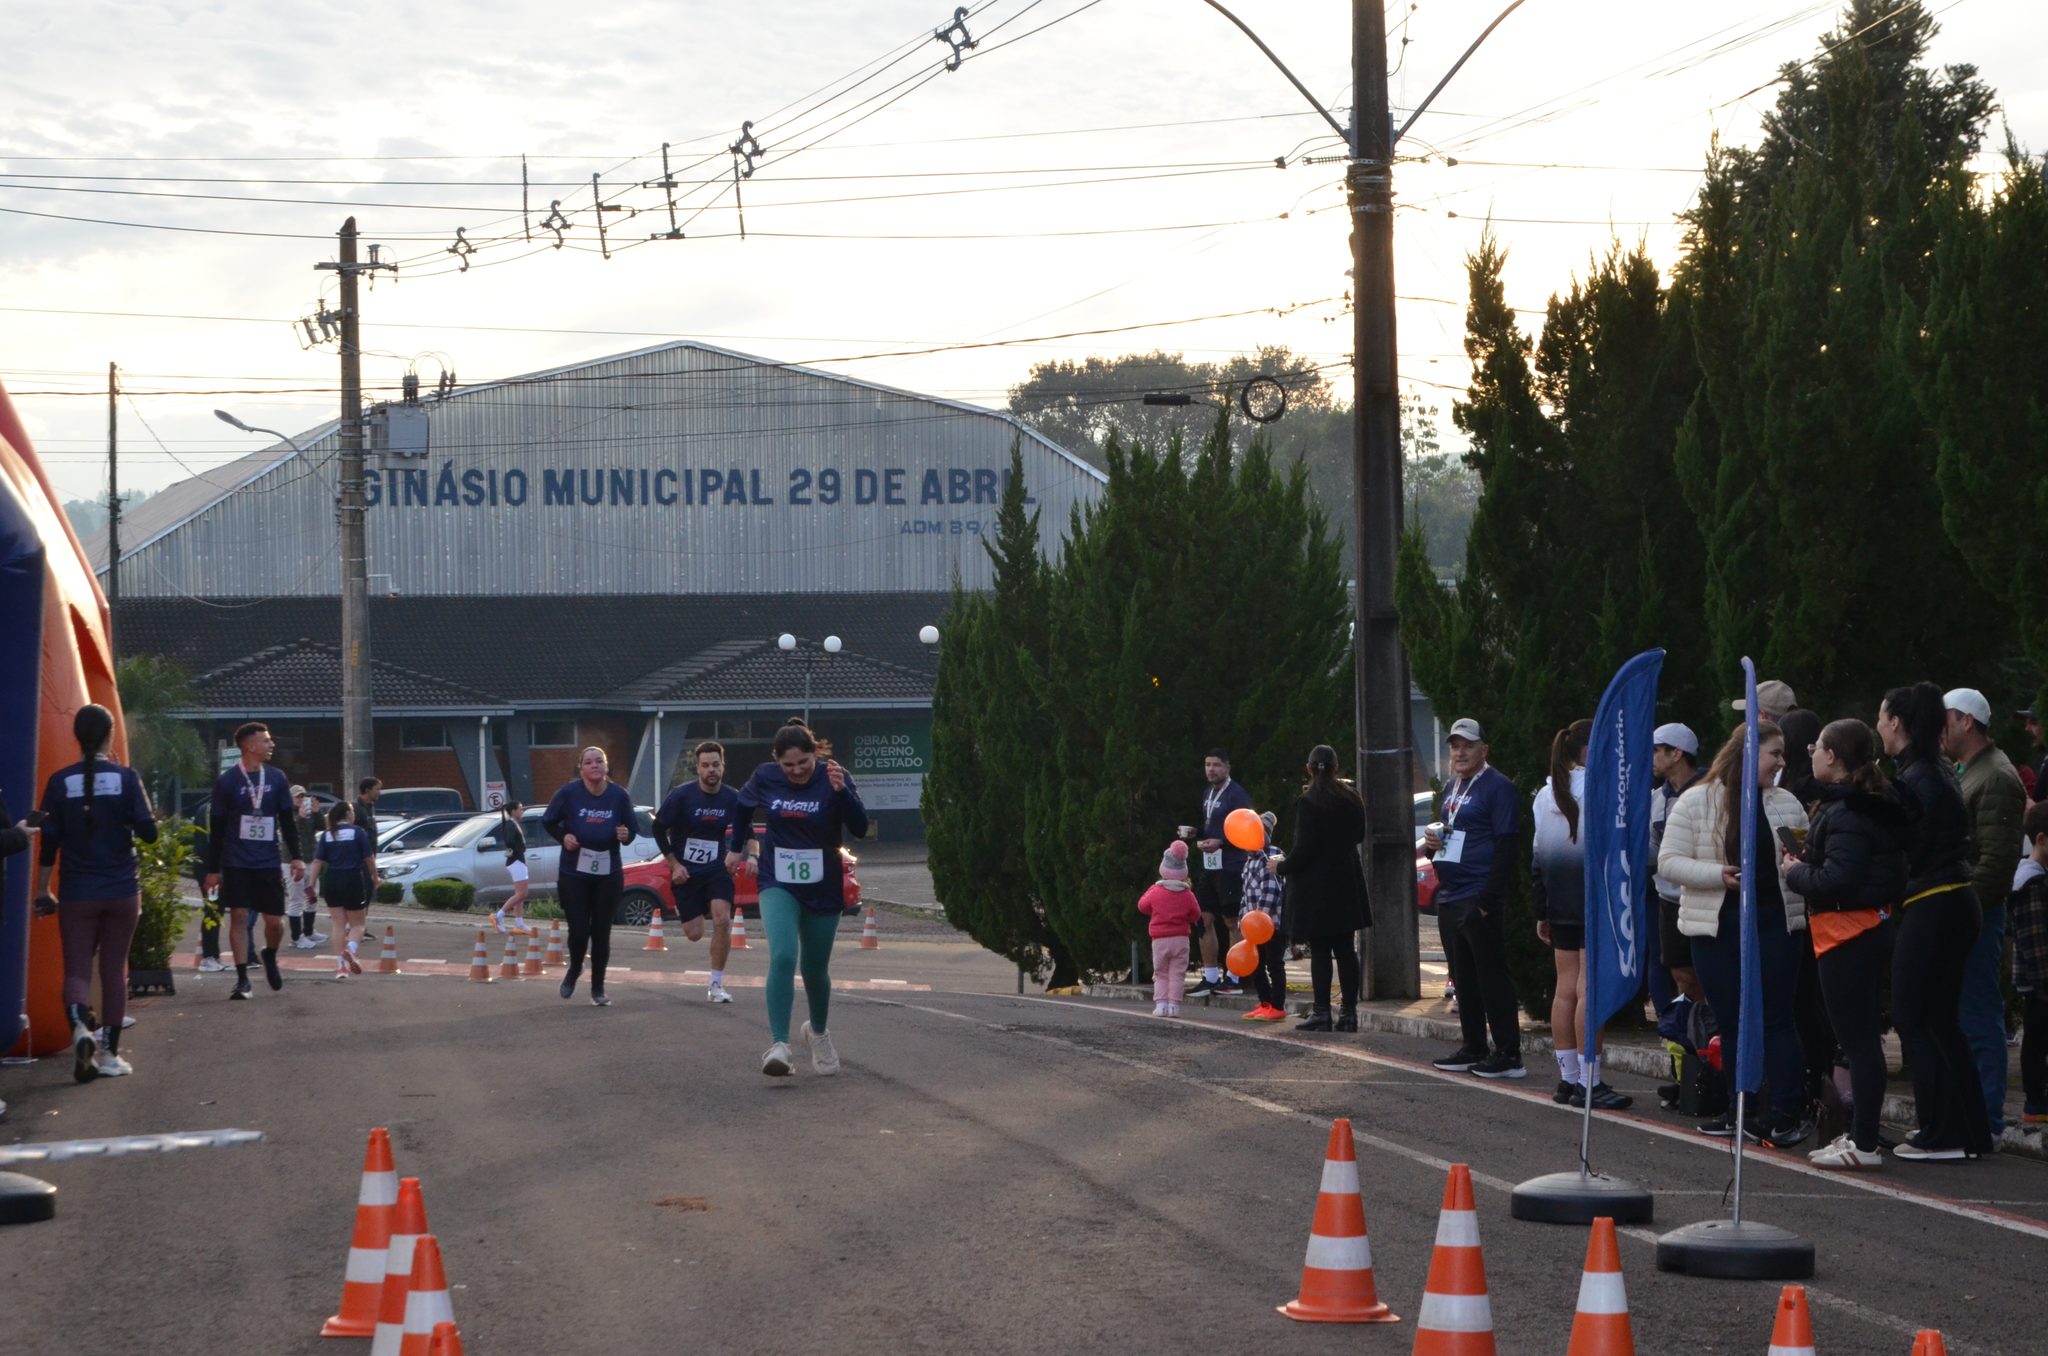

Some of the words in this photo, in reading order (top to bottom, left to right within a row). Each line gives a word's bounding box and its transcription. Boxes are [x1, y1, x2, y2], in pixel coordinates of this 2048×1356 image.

[363, 459, 527, 506] GINÁSIO
[543, 468, 774, 506] MUNICIPAL
[789, 468, 841, 505] 29
[855, 468, 906, 505] DE
[900, 520, 943, 535] ADM
[854, 735, 888, 745] OBRA
[892, 734, 910, 745] DO
[854, 746, 914, 757] GOVERNO
[854, 758, 873, 768] DO
[876, 757, 923, 768] ESTADO
[249, 825, 265, 838] 53
[688, 847, 712, 863] 721
[591, 860, 599, 872] 8
[787, 861, 810, 880] 18
